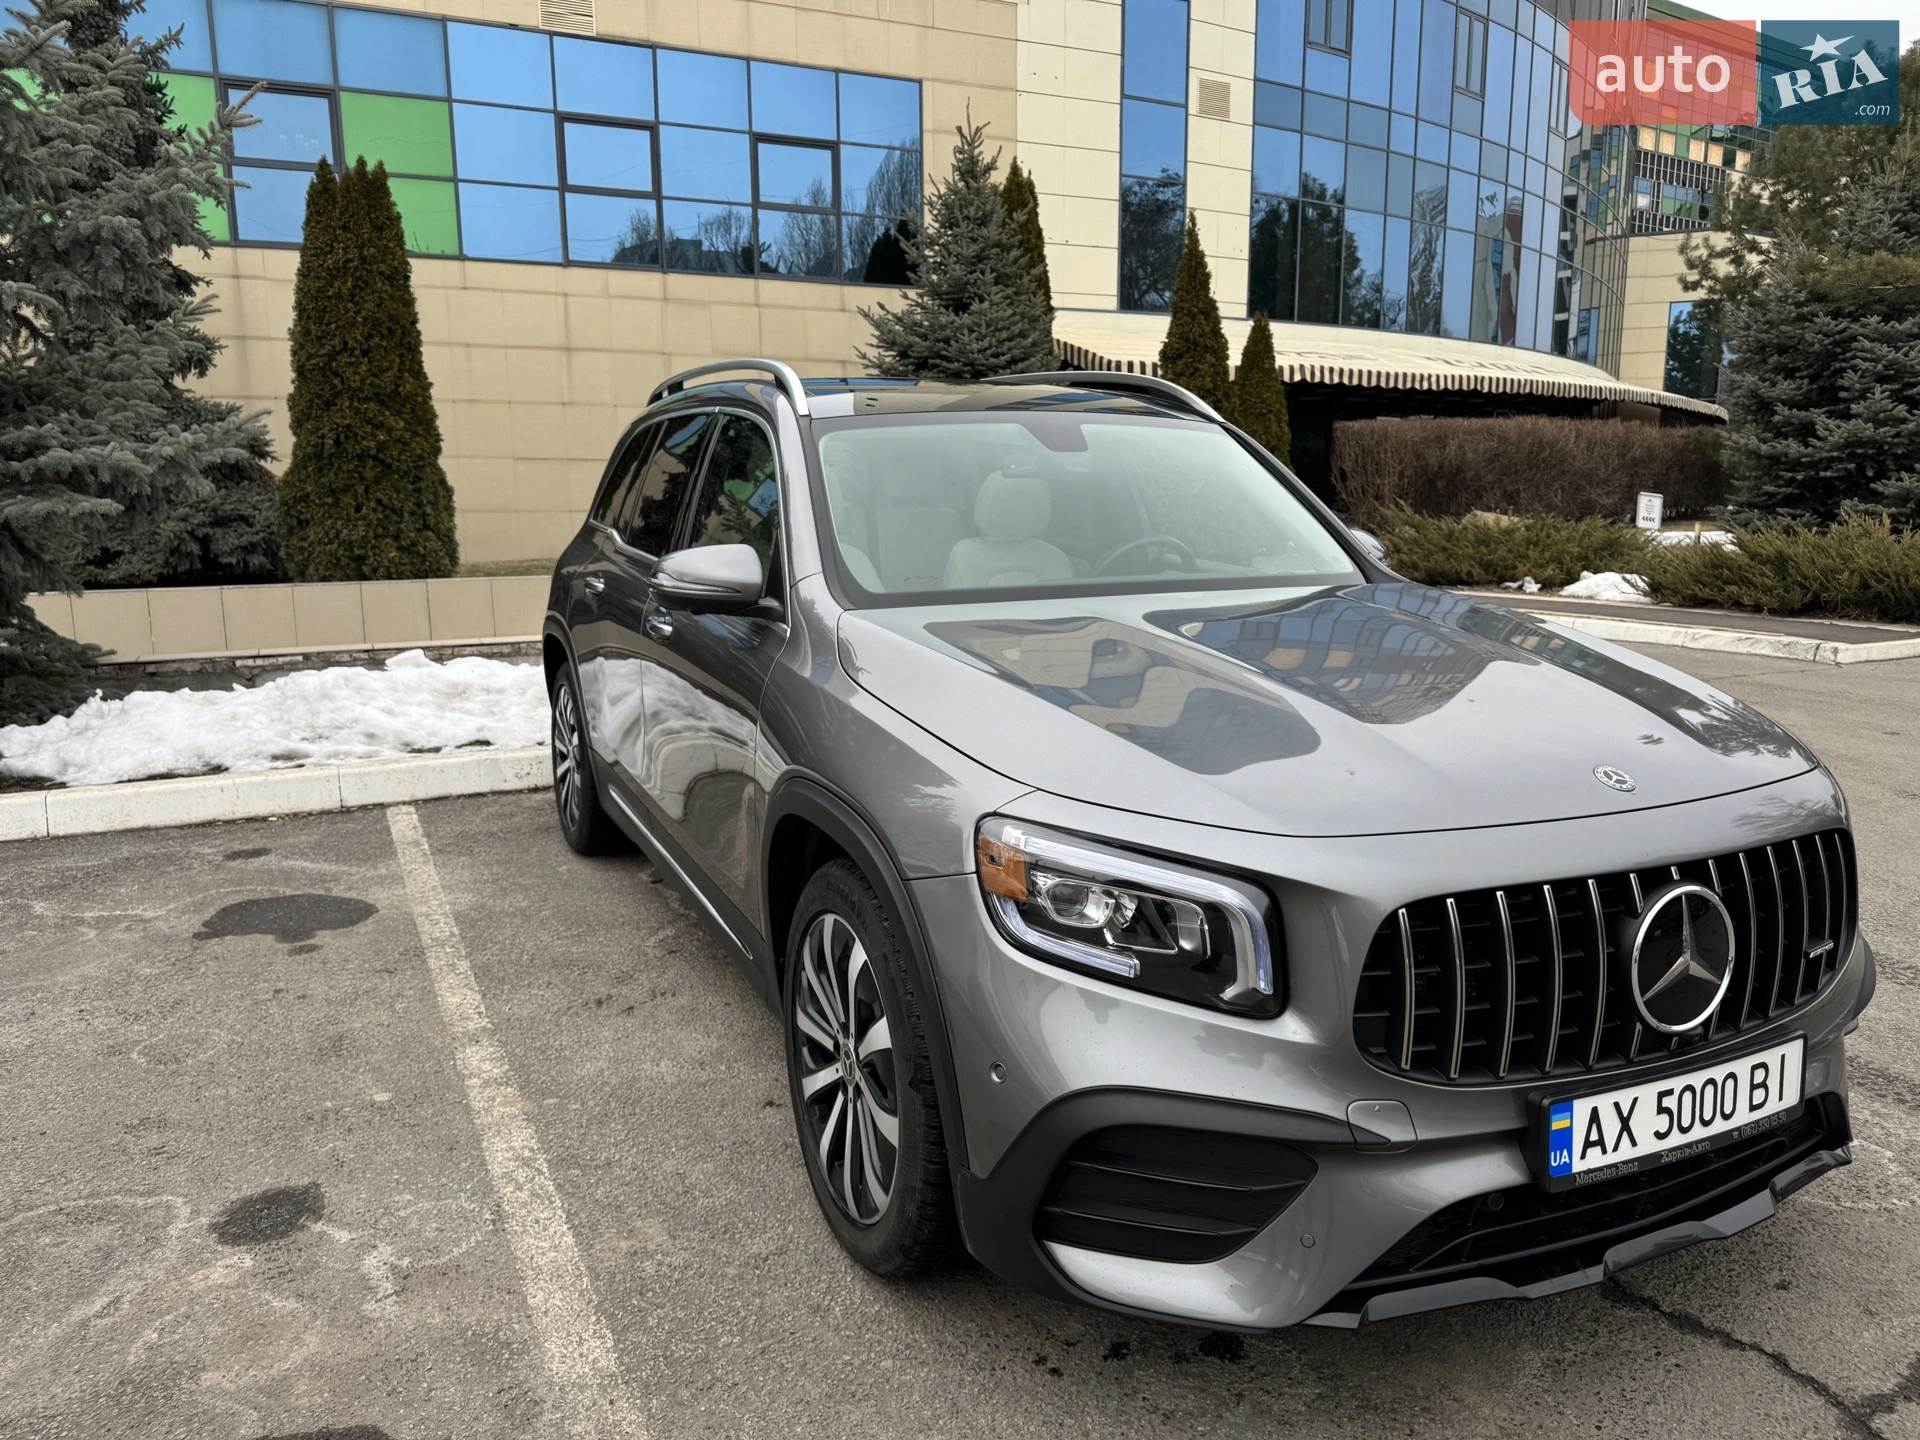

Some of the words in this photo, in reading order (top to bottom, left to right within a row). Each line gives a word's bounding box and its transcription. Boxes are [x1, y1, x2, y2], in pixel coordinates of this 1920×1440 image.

[1580, 1096, 1639, 1160] AX
[1653, 1072, 1738, 1141] 5000
[1749, 1053, 1786, 1113] BI
[1550, 1151, 1569, 1167] UA
[1575, 1162, 1639, 1186] Mercedes-Benz
